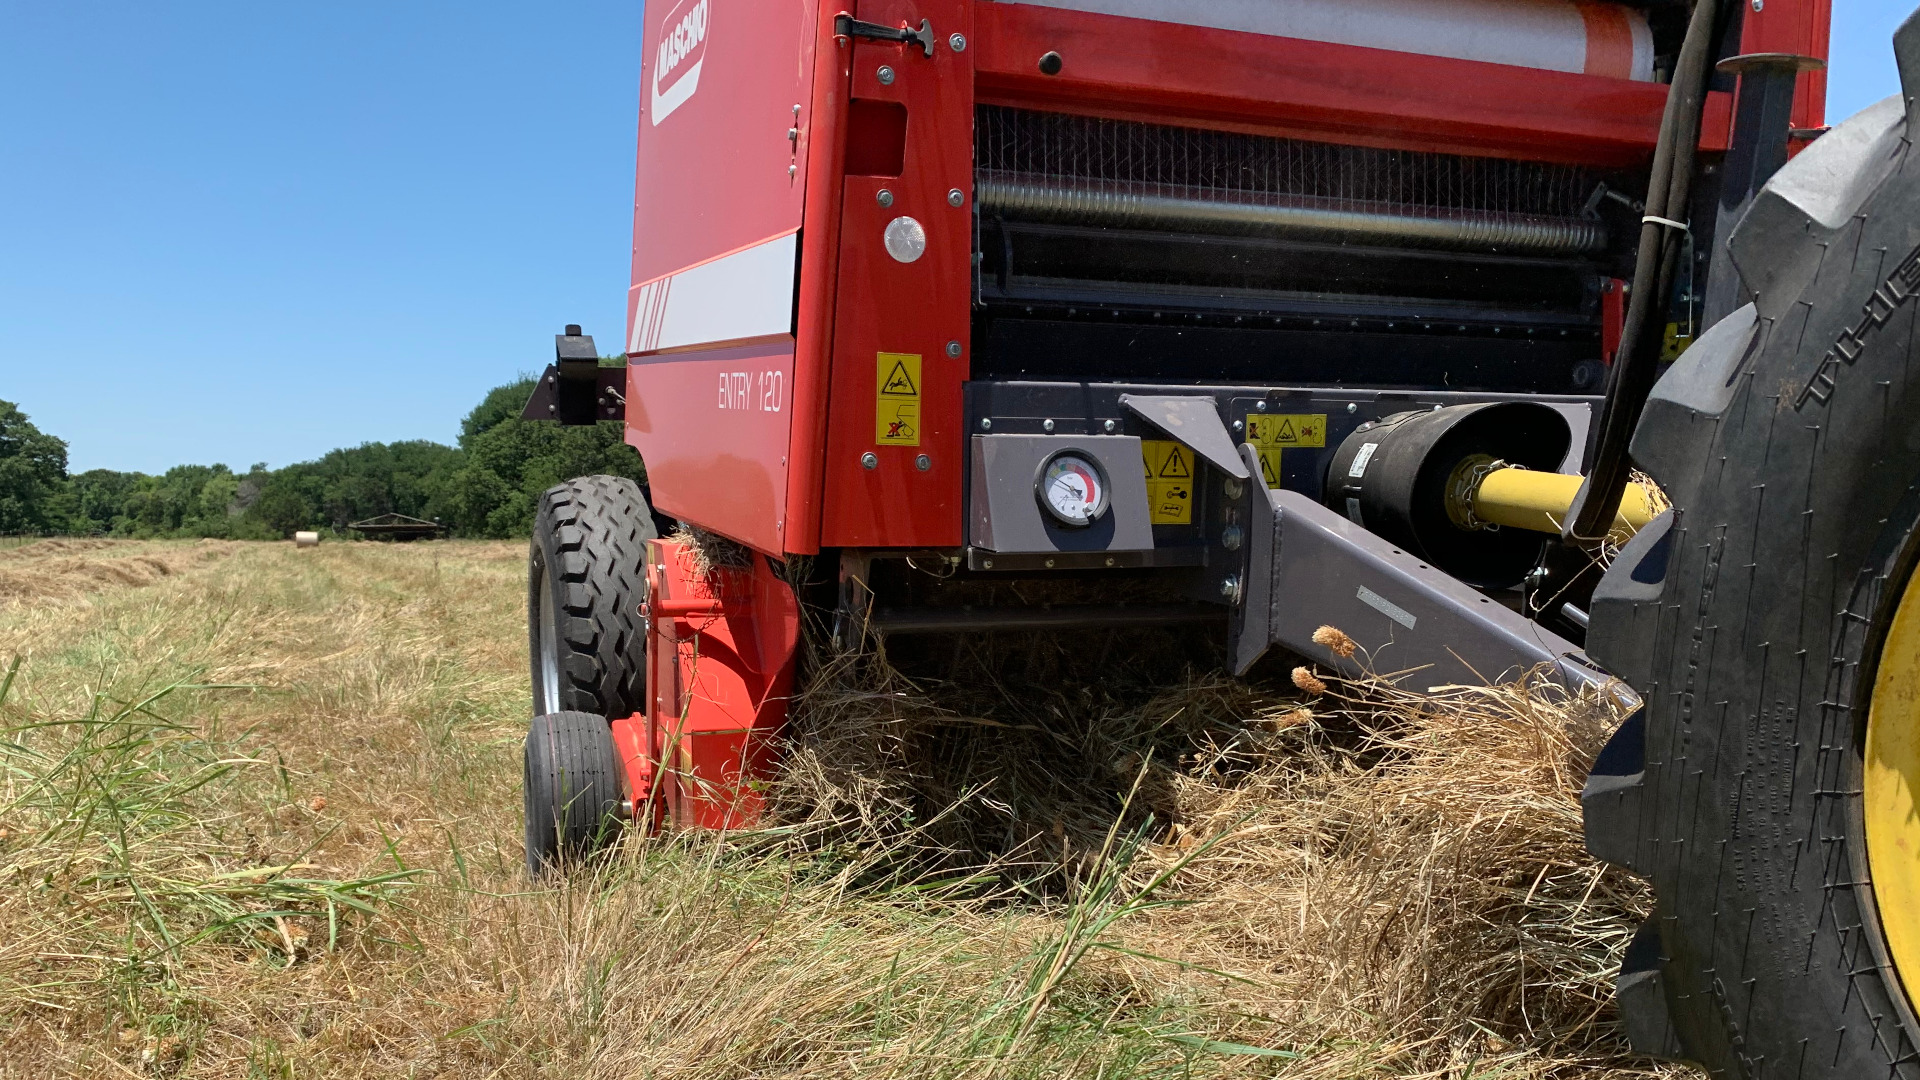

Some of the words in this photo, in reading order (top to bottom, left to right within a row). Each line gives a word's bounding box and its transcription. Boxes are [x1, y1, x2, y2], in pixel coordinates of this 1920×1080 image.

[658, 0, 708, 82] MASCHIO
[718, 372, 753, 410] ENTRY
[758, 370, 783, 412] 120
